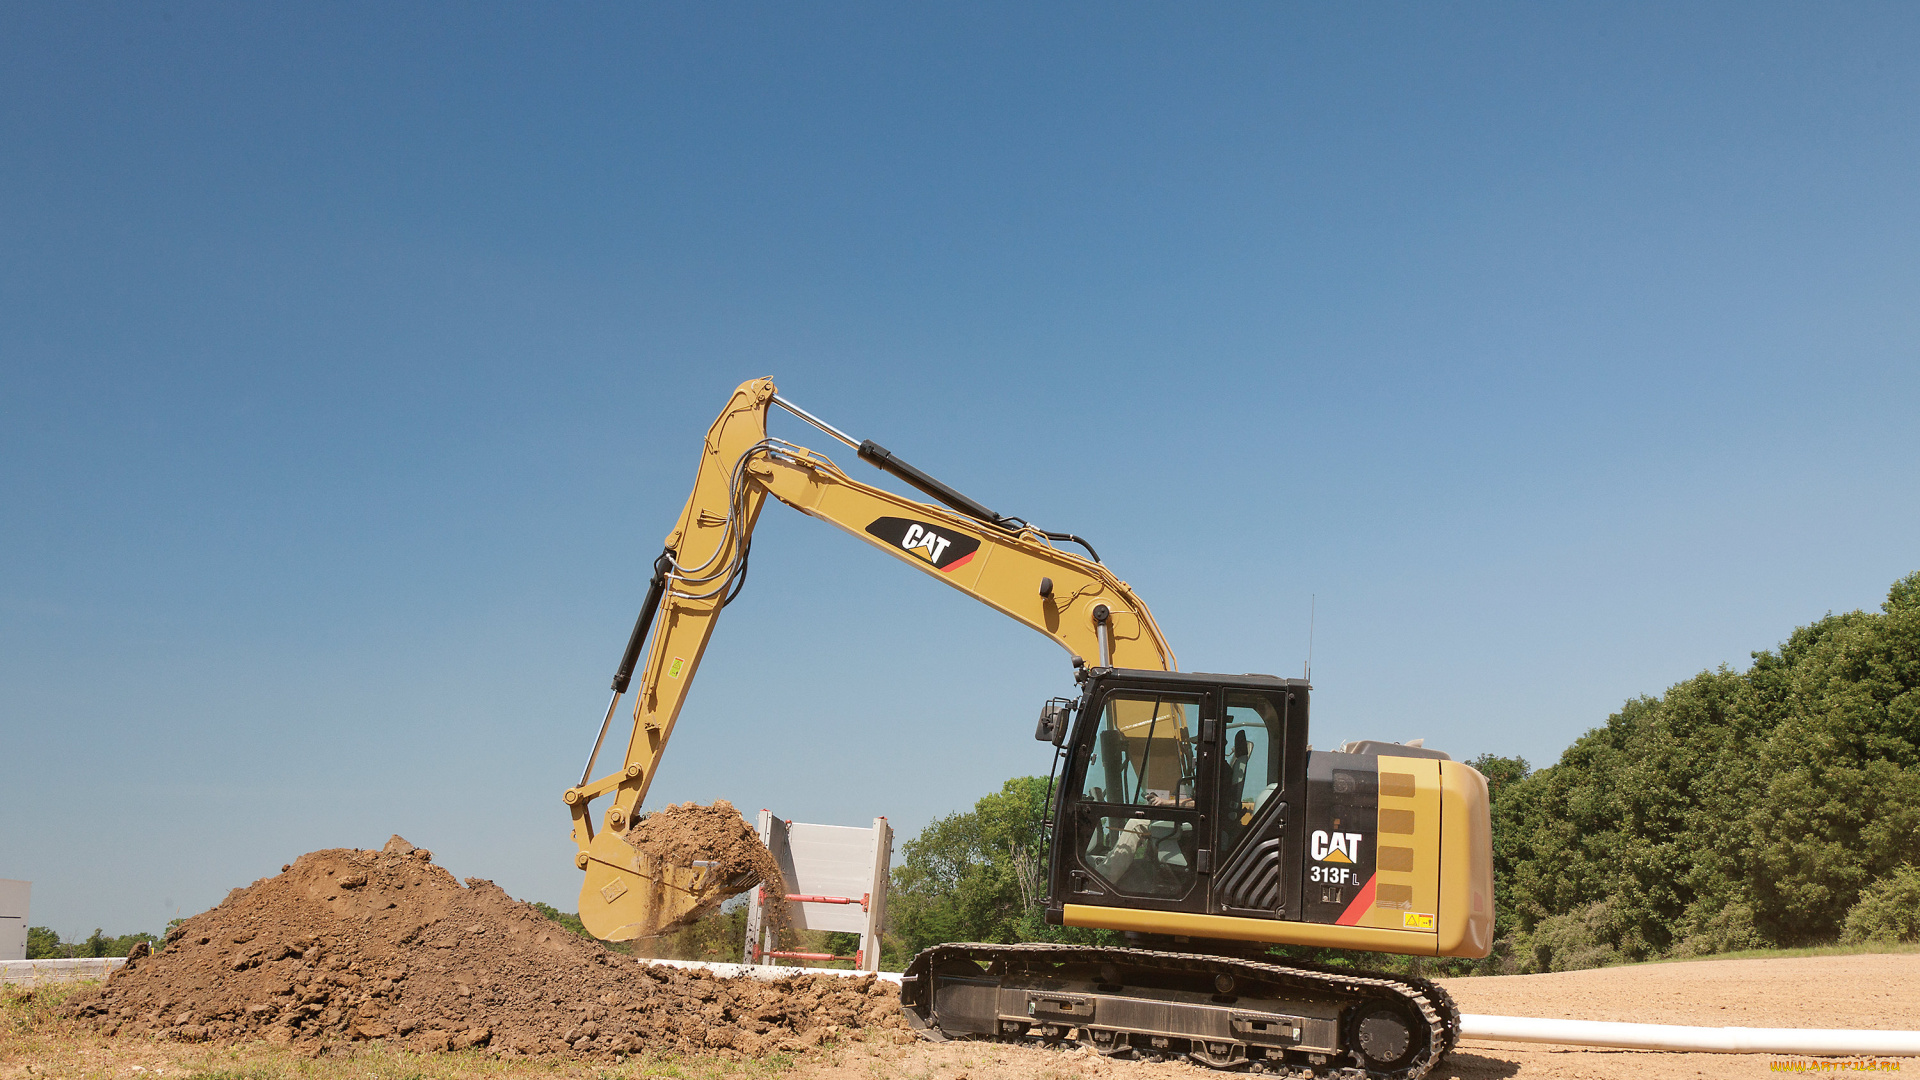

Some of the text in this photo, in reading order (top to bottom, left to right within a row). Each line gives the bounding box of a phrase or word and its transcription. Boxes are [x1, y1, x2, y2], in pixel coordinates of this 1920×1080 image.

[902, 523, 951, 564] CAT
[1310, 830, 1362, 864] CAT
[1310, 865, 1360, 886] 313F L
